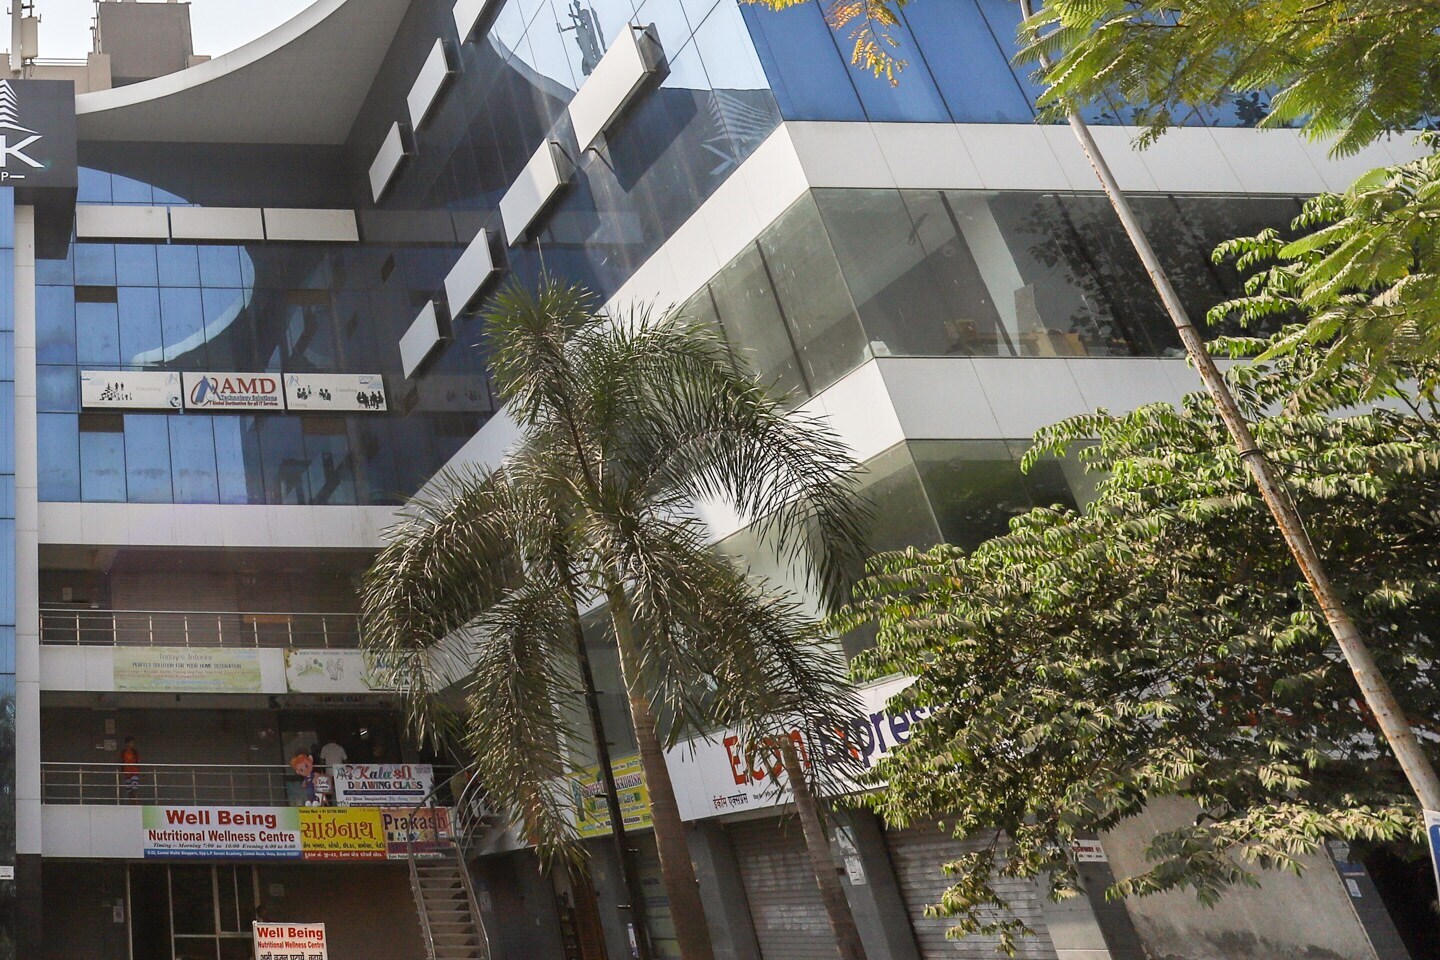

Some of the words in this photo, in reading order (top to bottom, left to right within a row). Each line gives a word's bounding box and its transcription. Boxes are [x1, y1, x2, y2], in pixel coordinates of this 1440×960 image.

[221, 378, 276, 394] AMD
[348, 781, 391, 790] DRAWING
[393, 781, 423, 790] CLASS
[166, 809, 210, 825] Well
[217, 810, 277, 829] Being
[148, 829, 205, 841] Nutritional
[208, 830, 256, 842] Wellness
[258, 830, 295, 842] Centre
[257, 927, 284, 938] Well
[288, 927, 324, 940] Being
[257, 941, 284, 949] Nutritional
[284, 941, 307, 949] Wellness
[307, 941, 325, 949] Centre
